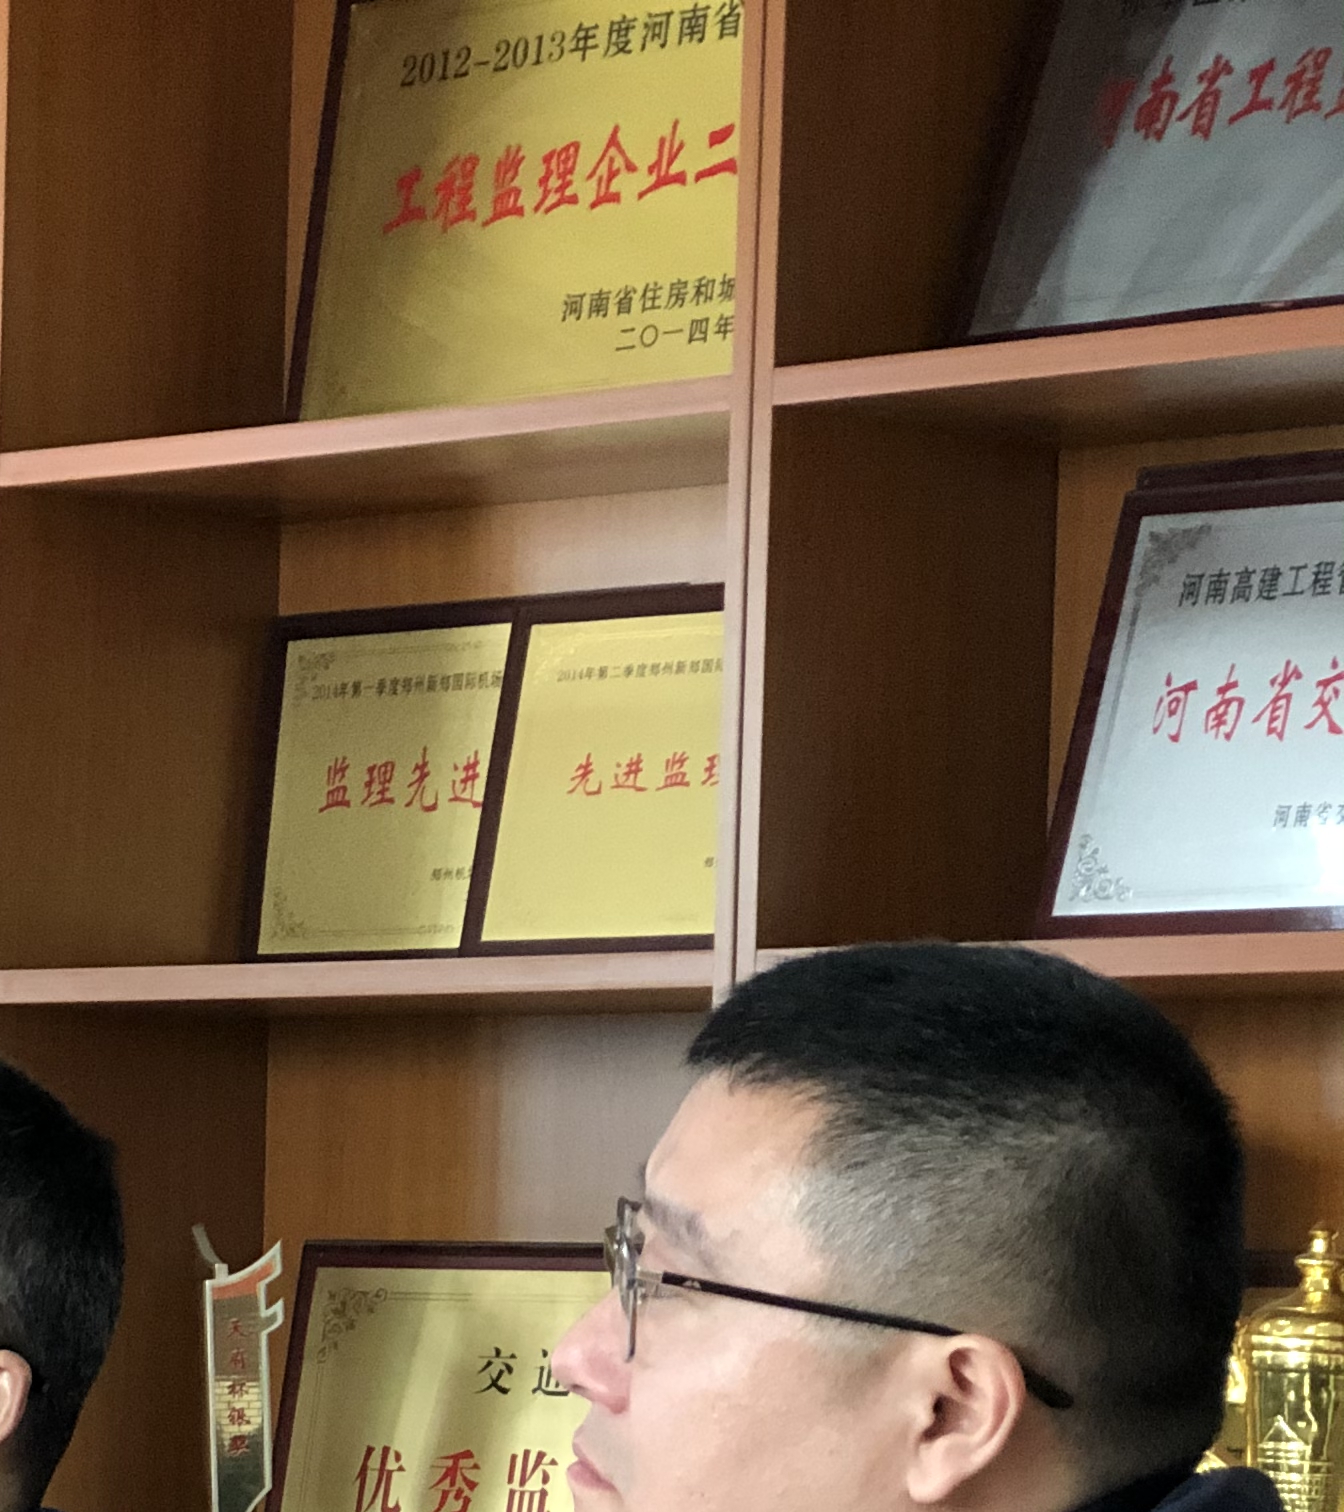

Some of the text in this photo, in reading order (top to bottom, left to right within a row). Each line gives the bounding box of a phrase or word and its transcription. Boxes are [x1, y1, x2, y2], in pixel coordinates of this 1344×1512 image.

[400, 0, 742, 88] 2012-2013年度河南省
[1096, 46, 1344, 150] 河南省工程
[383, 118, 738, 234] 工程监理企业二
[1178, 560, 1344, 608] 河南高建工程
[318, 745, 484, 814] 监理先进
